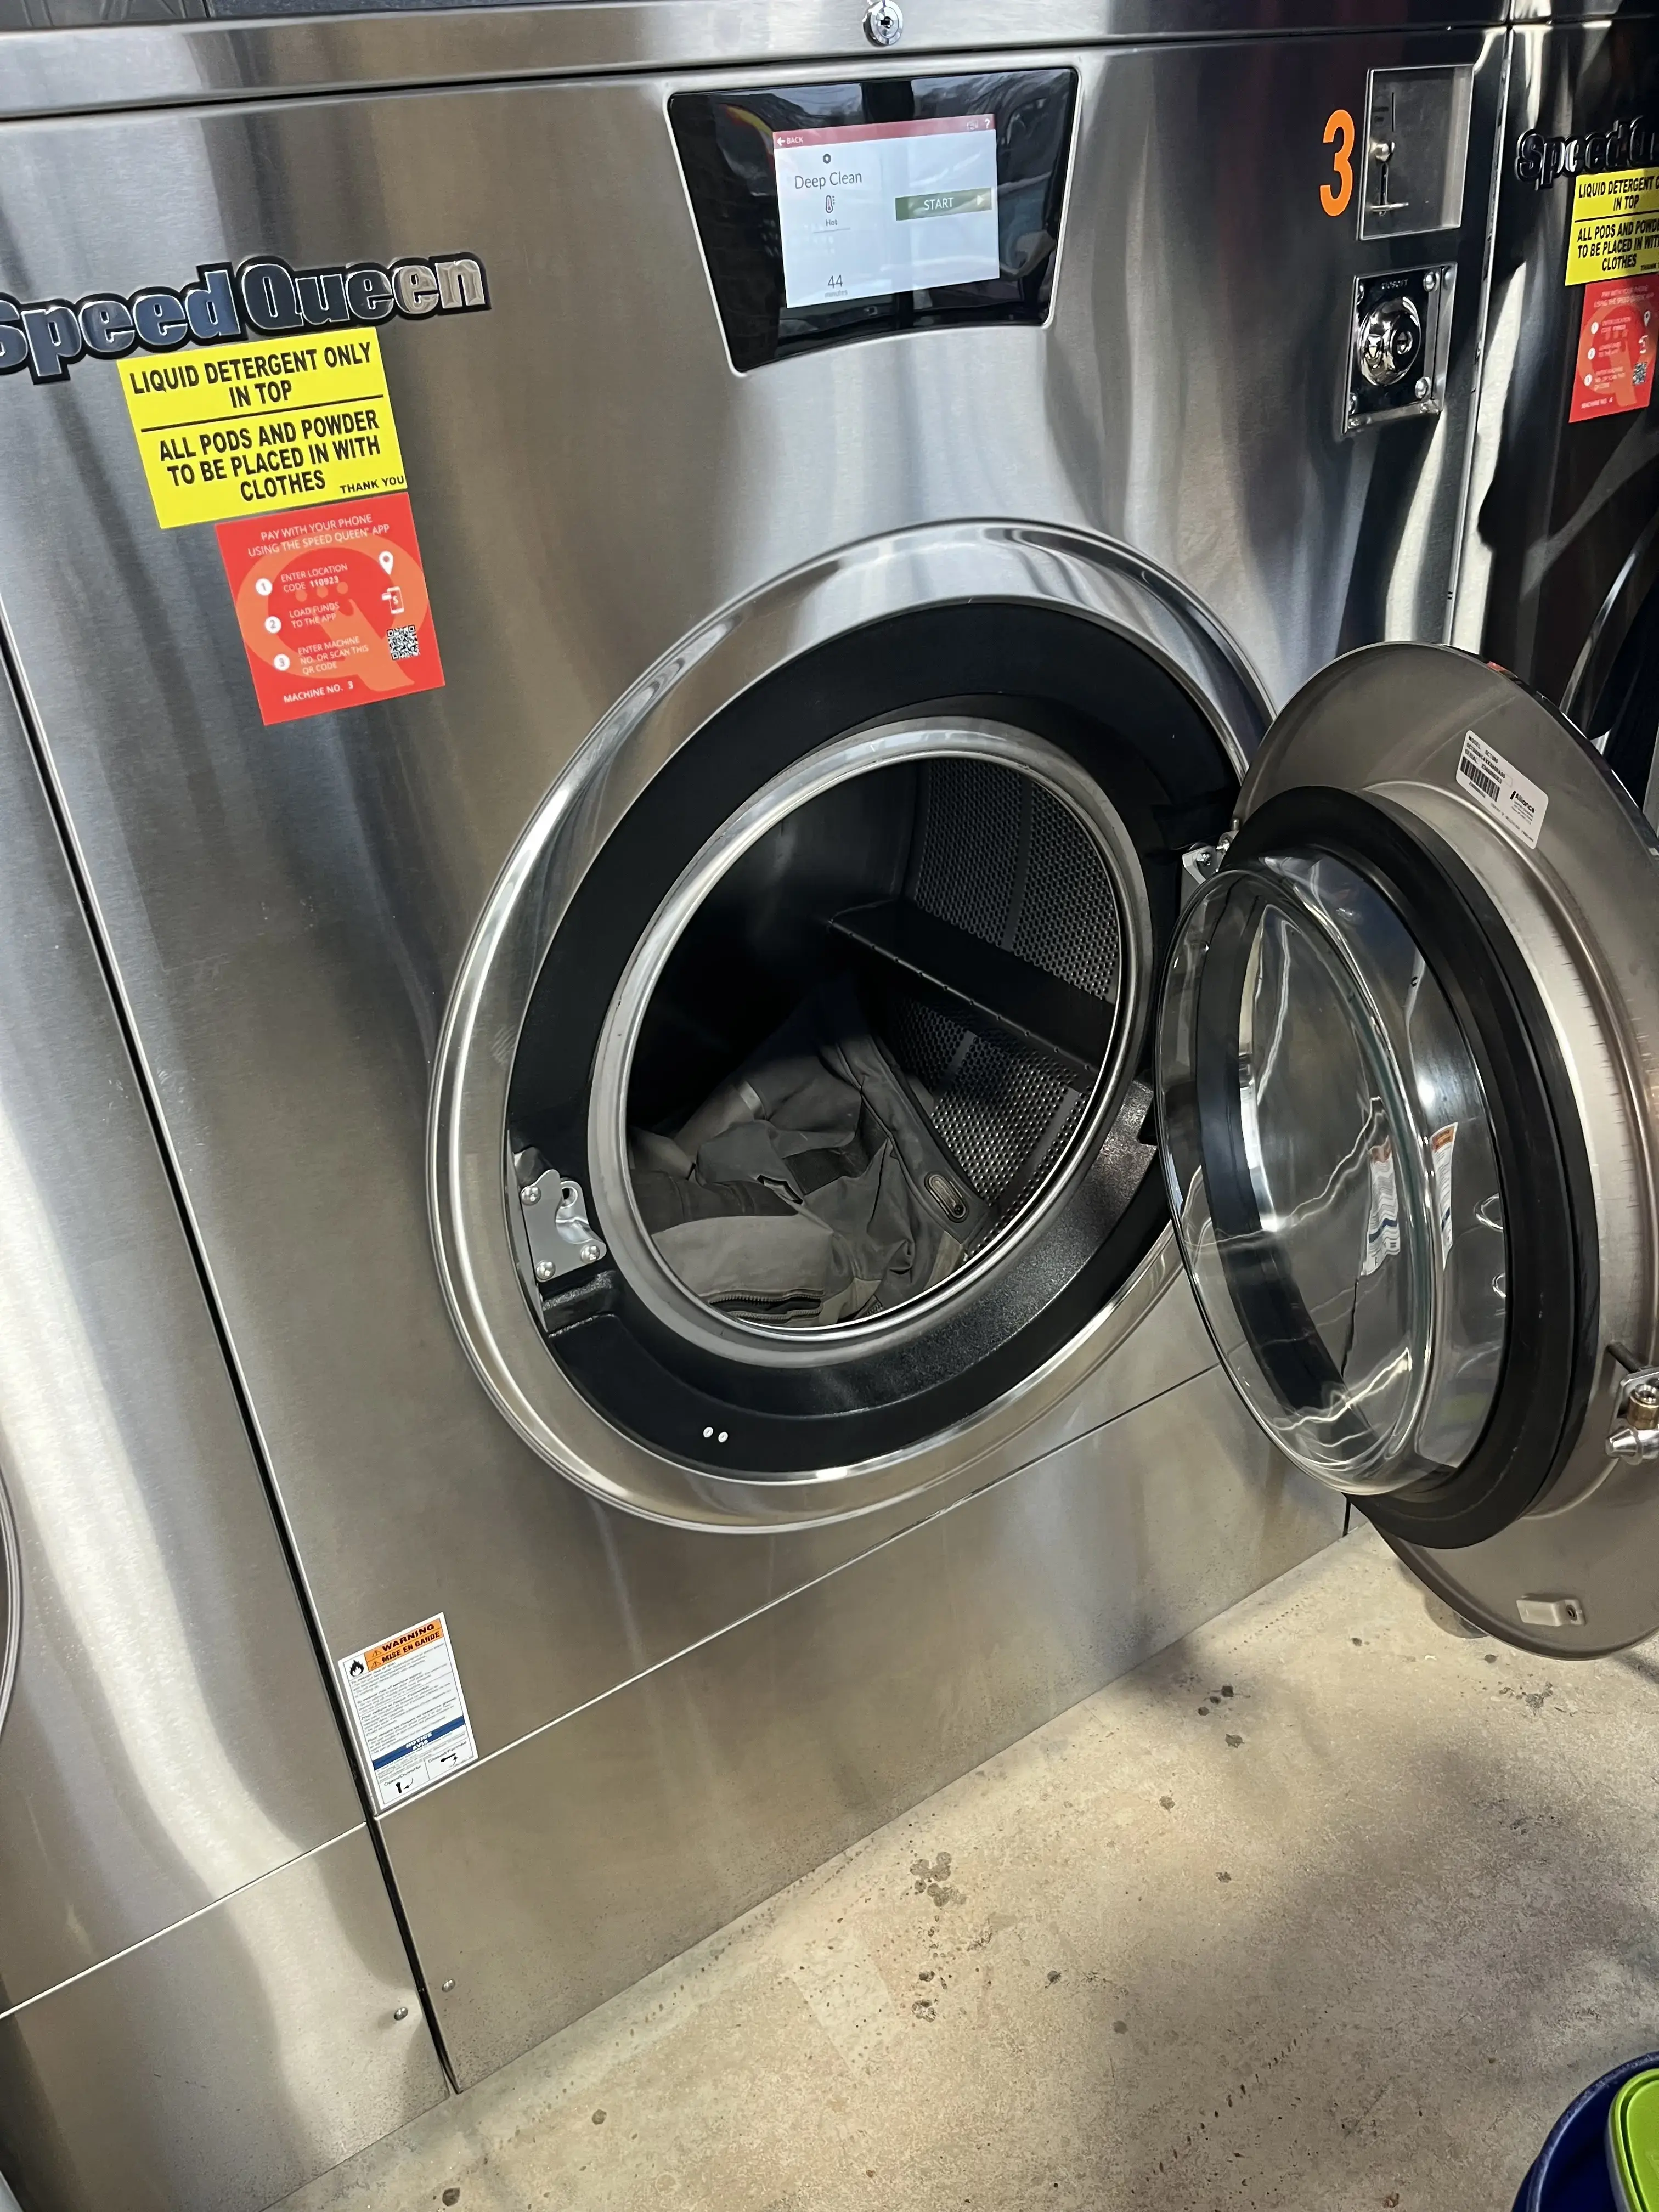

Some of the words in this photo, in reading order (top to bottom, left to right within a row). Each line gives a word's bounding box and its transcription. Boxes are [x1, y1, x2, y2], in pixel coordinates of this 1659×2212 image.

[786, 136, 803, 144] BACK
[1319, 109, 1355, 216] 3
[795, 176, 826, 190] Deep
[830, 171, 862, 185] Clean
[1578, 182, 1605, 198] LIQUID
[1608, 176, 1654, 194] DETERGENT
[924, 197, 954, 211] START
[1613, 197, 1622, 211] IN
[1624, 195, 1639, 209] TOP
[1577, 227, 1591, 242] ALL
[1594, 224, 1615, 240] PODS
[1617, 222, 1633, 236] AND
[1635, 218, 1659, 234] POWD
[1578, 244, 1588, 258] TO
[1590, 242, 1601, 257] BE
[1602, 237, 1632, 255] PLACED
[1634, 236, 1642, 251] IN
[1644, 234, 1659, 249] WIT
[1602, 253, 1637, 272] CLOTHES
[827, 274, 843, 289] 44
[238, 253, 490, 332] Queen
[130, 365, 199, 394] LIQUID
[204, 349, 317, 384] DETERGENT
[324, 342, 370, 368] ONLY
[229, 385, 251, 408] IN
[255, 380, 291, 404] TOP
[160, 437, 196, 461] ALL
[200, 428, 252, 455] PODS
[259, 421, 296, 447] AND
[301, 409, 380, 439] POWDER
[167, 464, 195, 486] TO
[200, 458, 227, 482] BE
[230, 447, 304, 477] PLACED
[309, 442, 329, 465] IN
[332, 434, 380, 460] WITH
[241, 469, 325, 501] CLOTHES
[340, 479, 379, 493] THANK
[382, 475, 404, 487] YOU
[261, 531, 279, 541] PAY
[281, 524, 307, 538] WITH
[309, 520, 337, 533] YOUR
[338, 514, 373, 528] PHONE
[248, 545, 280, 557] USING
[281, 539, 300, 551] THE
[302, 534, 332, 548] SPEED
[371, 524, 390, 535] APP
[280, 571, 307, 582] ENTER
[308, 563, 348, 578] LOCATION
[283, 582, 306, 592] CODE
[309, 575, 339, 588] 110923
[289, 607, 311, 618] LOAD
[312, 602, 340, 614] FUNDS
[269, 620, 276, 629] 2
[291, 619, 303, 628] TO
[304, 616, 320, 625] THE
[321, 613, 336, 623] APP
[298, 644, 322, 656] ENTER
[324, 636, 360, 650] MACHINE
[300, 656, 314, 665] NO.
[318, 652, 328, 661] OR
[330, 648, 351, 659] SCAN
[352, 644, 369, 654] THIS
[279, 658, 285, 667] 3
[302, 665, 314, 675] QR
[315, 662, 338, 673] CODE
[283, 686, 325, 703] MACHINE
[326, 684, 343, 694] NO.
[347, 681, 354, 690] 3
[382, 1624, 435, 1651] WARNING
[382, 1650, 401, 1663] MISE
[404, 1644, 414, 1654] EN
[415, 1631, 440, 1646] GARDE
[406, 1732, 433, 1749] NOTICE
